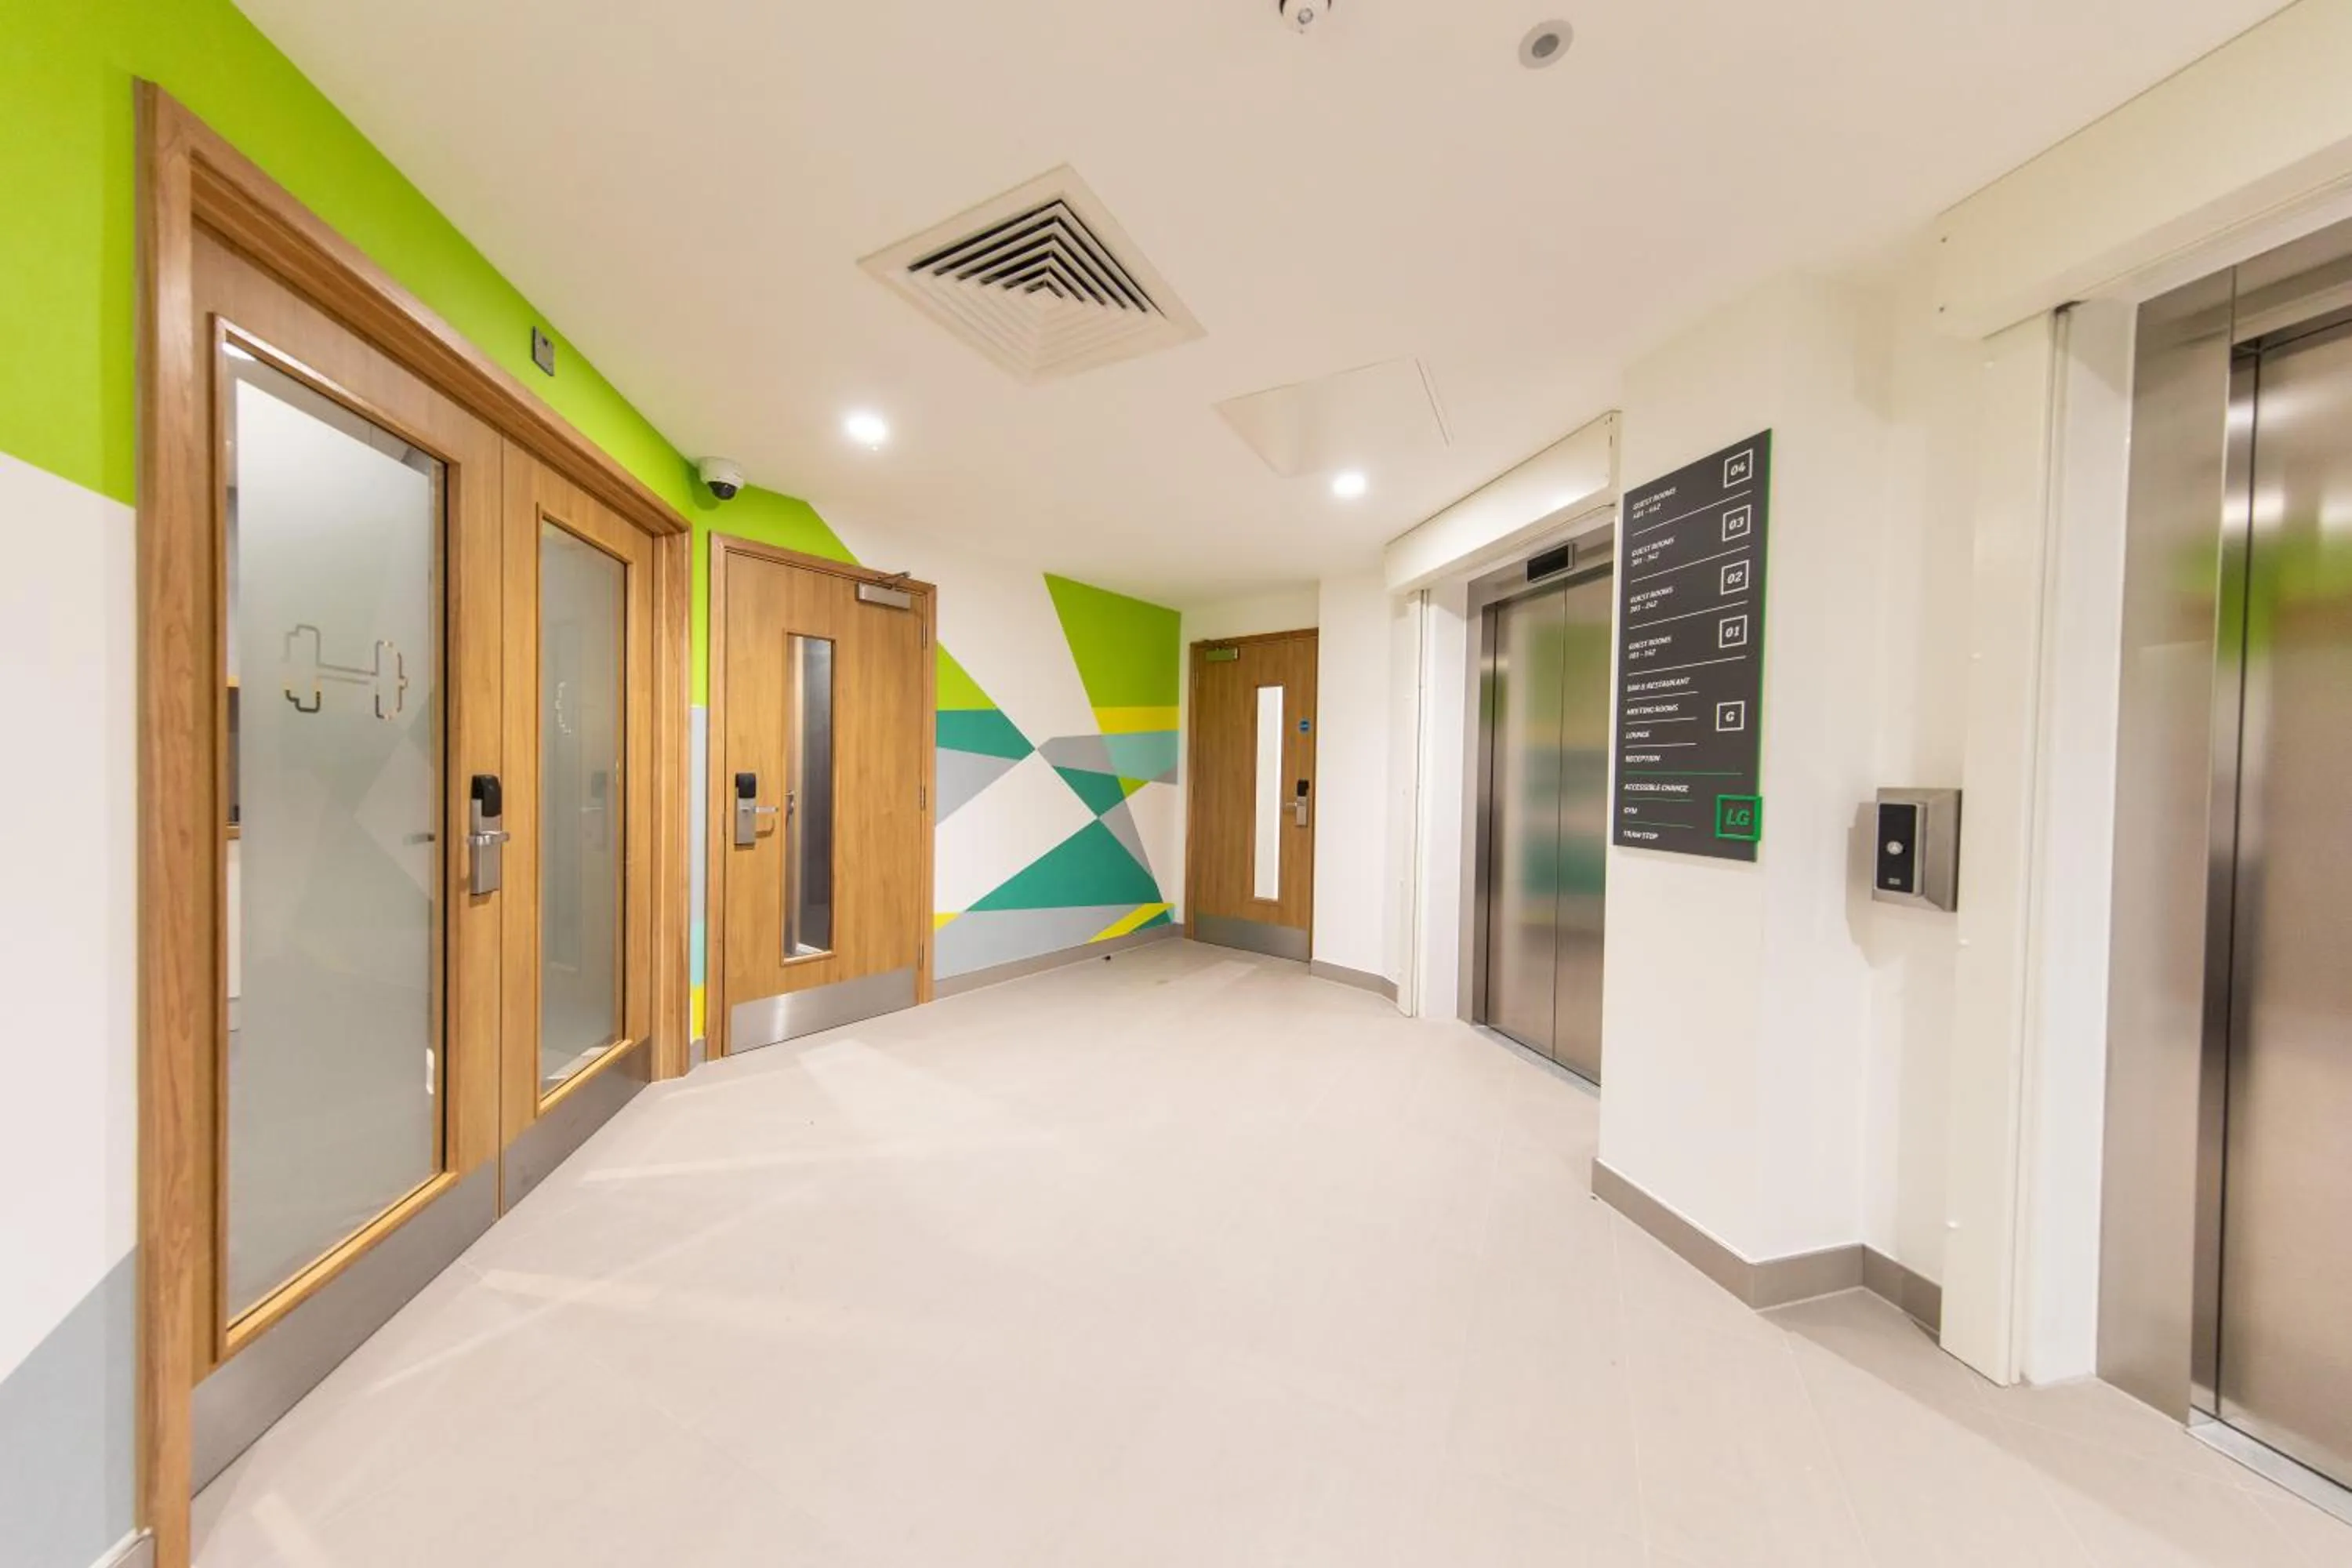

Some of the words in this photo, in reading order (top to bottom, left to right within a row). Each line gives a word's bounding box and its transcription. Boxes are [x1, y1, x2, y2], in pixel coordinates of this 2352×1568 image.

[1730, 463, 1746, 476] 04
[1729, 517, 1744, 531] 03
[1727, 572, 1744, 584] 02
[1726, 626, 1740, 637] 01
[1649, 636, 1671, 646] ROOMS
[1646, 677, 1691, 689] RESTAURANT
[1655, 703, 1679, 712] ROOMS
[1726, 711, 1735, 722] G
[1726, 808, 1751, 826] LG
